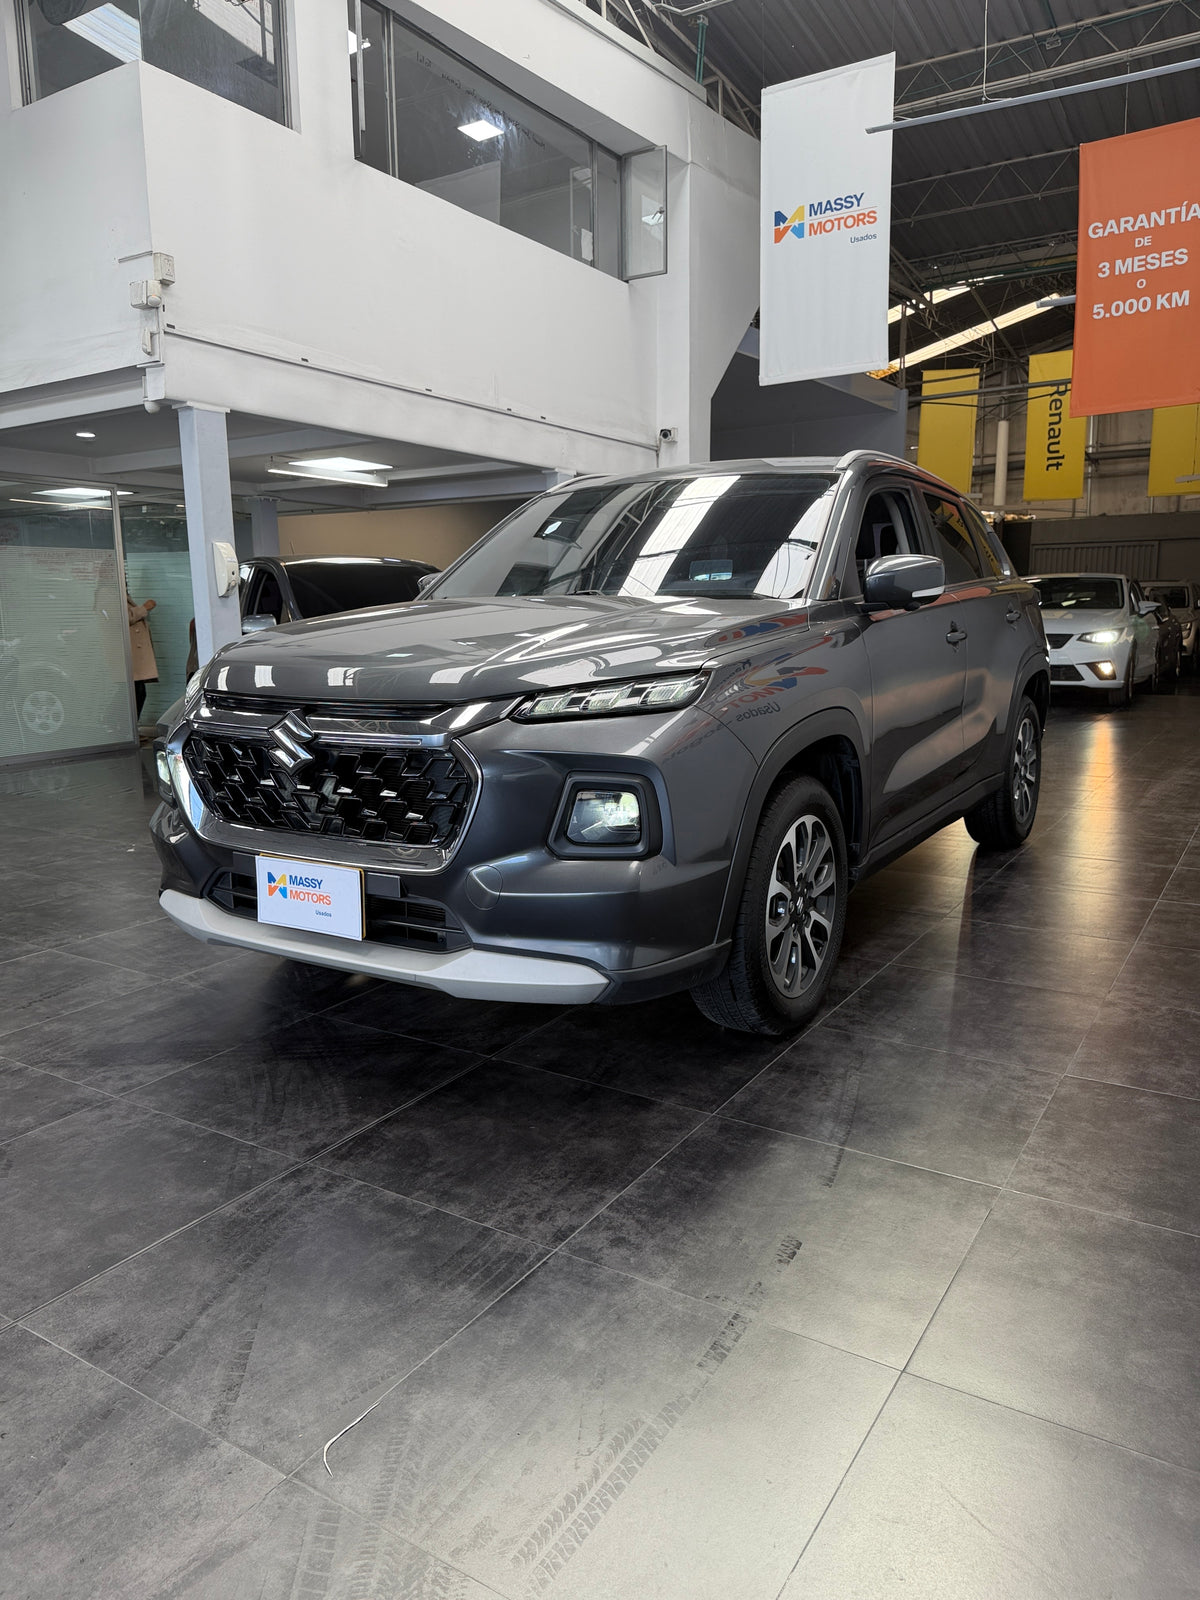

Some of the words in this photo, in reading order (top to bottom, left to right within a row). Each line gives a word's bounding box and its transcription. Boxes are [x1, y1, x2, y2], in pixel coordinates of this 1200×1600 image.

[808, 192, 865, 217] MASSY
[808, 210, 878, 236] MOTORS
[1087, 200, 1200, 239] GARANTÍA
[849, 233, 878, 244] Usados
[1134, 236, 1153, 248] DE
[1097, 262, 1111, 278] 3
[1114, 248, 1189, 276] MESES
[1136, 278, 1147, 289] O
[1092, 296, 1152, 320] 5.000
[1156, 289, 1190, 310] KM
[1045, 382, 1070, 472] Renault
[289, 875, 323, 889] MASSY
[289, 889, 332, 906] MOTORS
[315, 909, 332, 918] Usados
